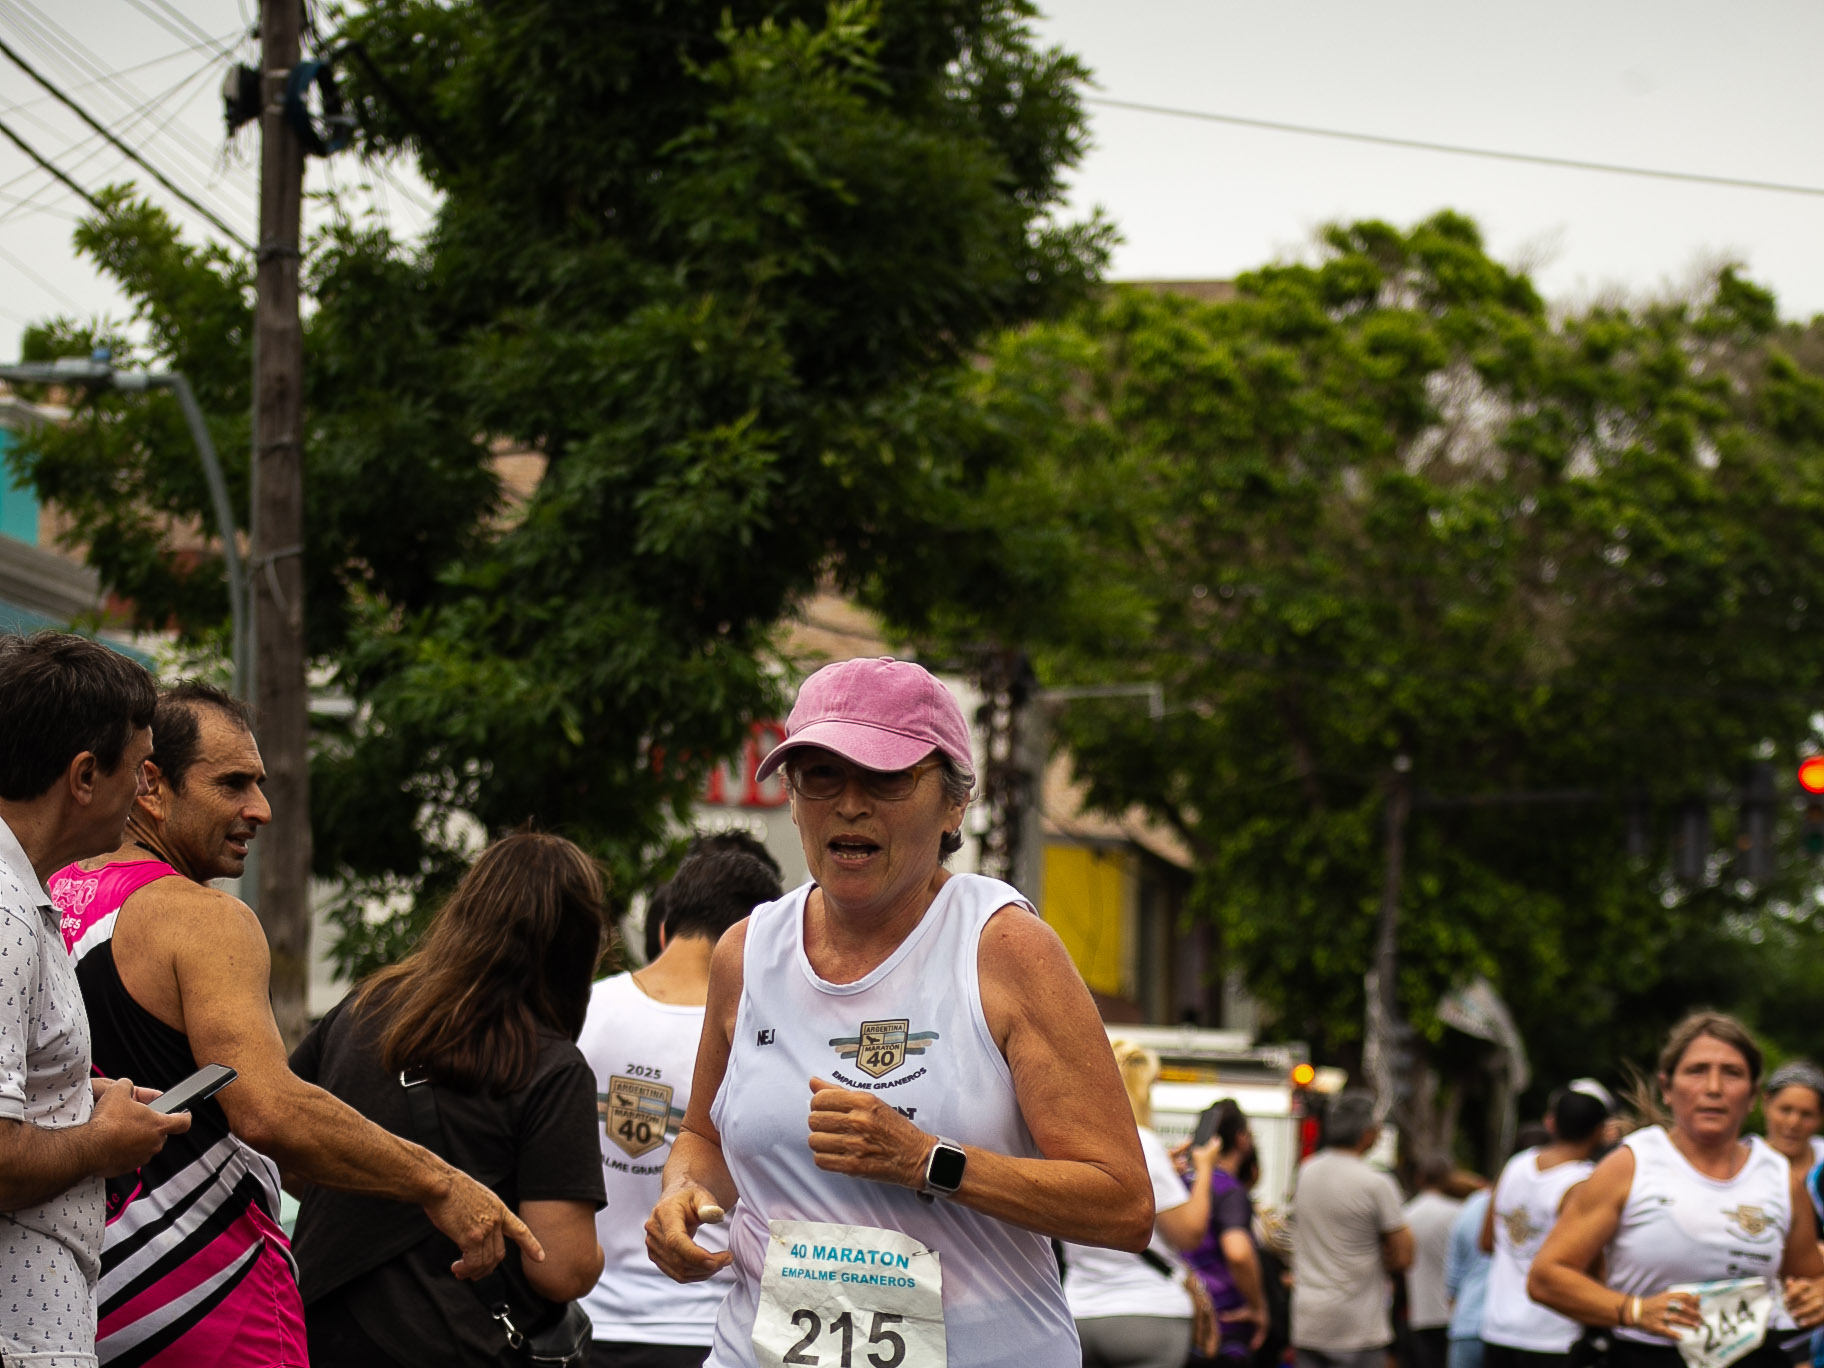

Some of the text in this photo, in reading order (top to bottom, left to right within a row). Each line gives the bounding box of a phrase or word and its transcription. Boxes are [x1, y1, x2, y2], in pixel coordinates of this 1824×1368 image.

[756, 1028, 776, 1046] NEJ
[866, 1025, 903, 1033] ARGENTINA
[866, 1051, 895, 1067] 40
[625, 1064, 662, 1080] 2025
[831, 1067, 927, 1090] EMPALME GRANEROS
[618, 1119, 652, 1144] 40
[790, 1243, 910, 1269] 40 MARATON
[781, 1266, 916, 1288] EMPALME GRANEROS
